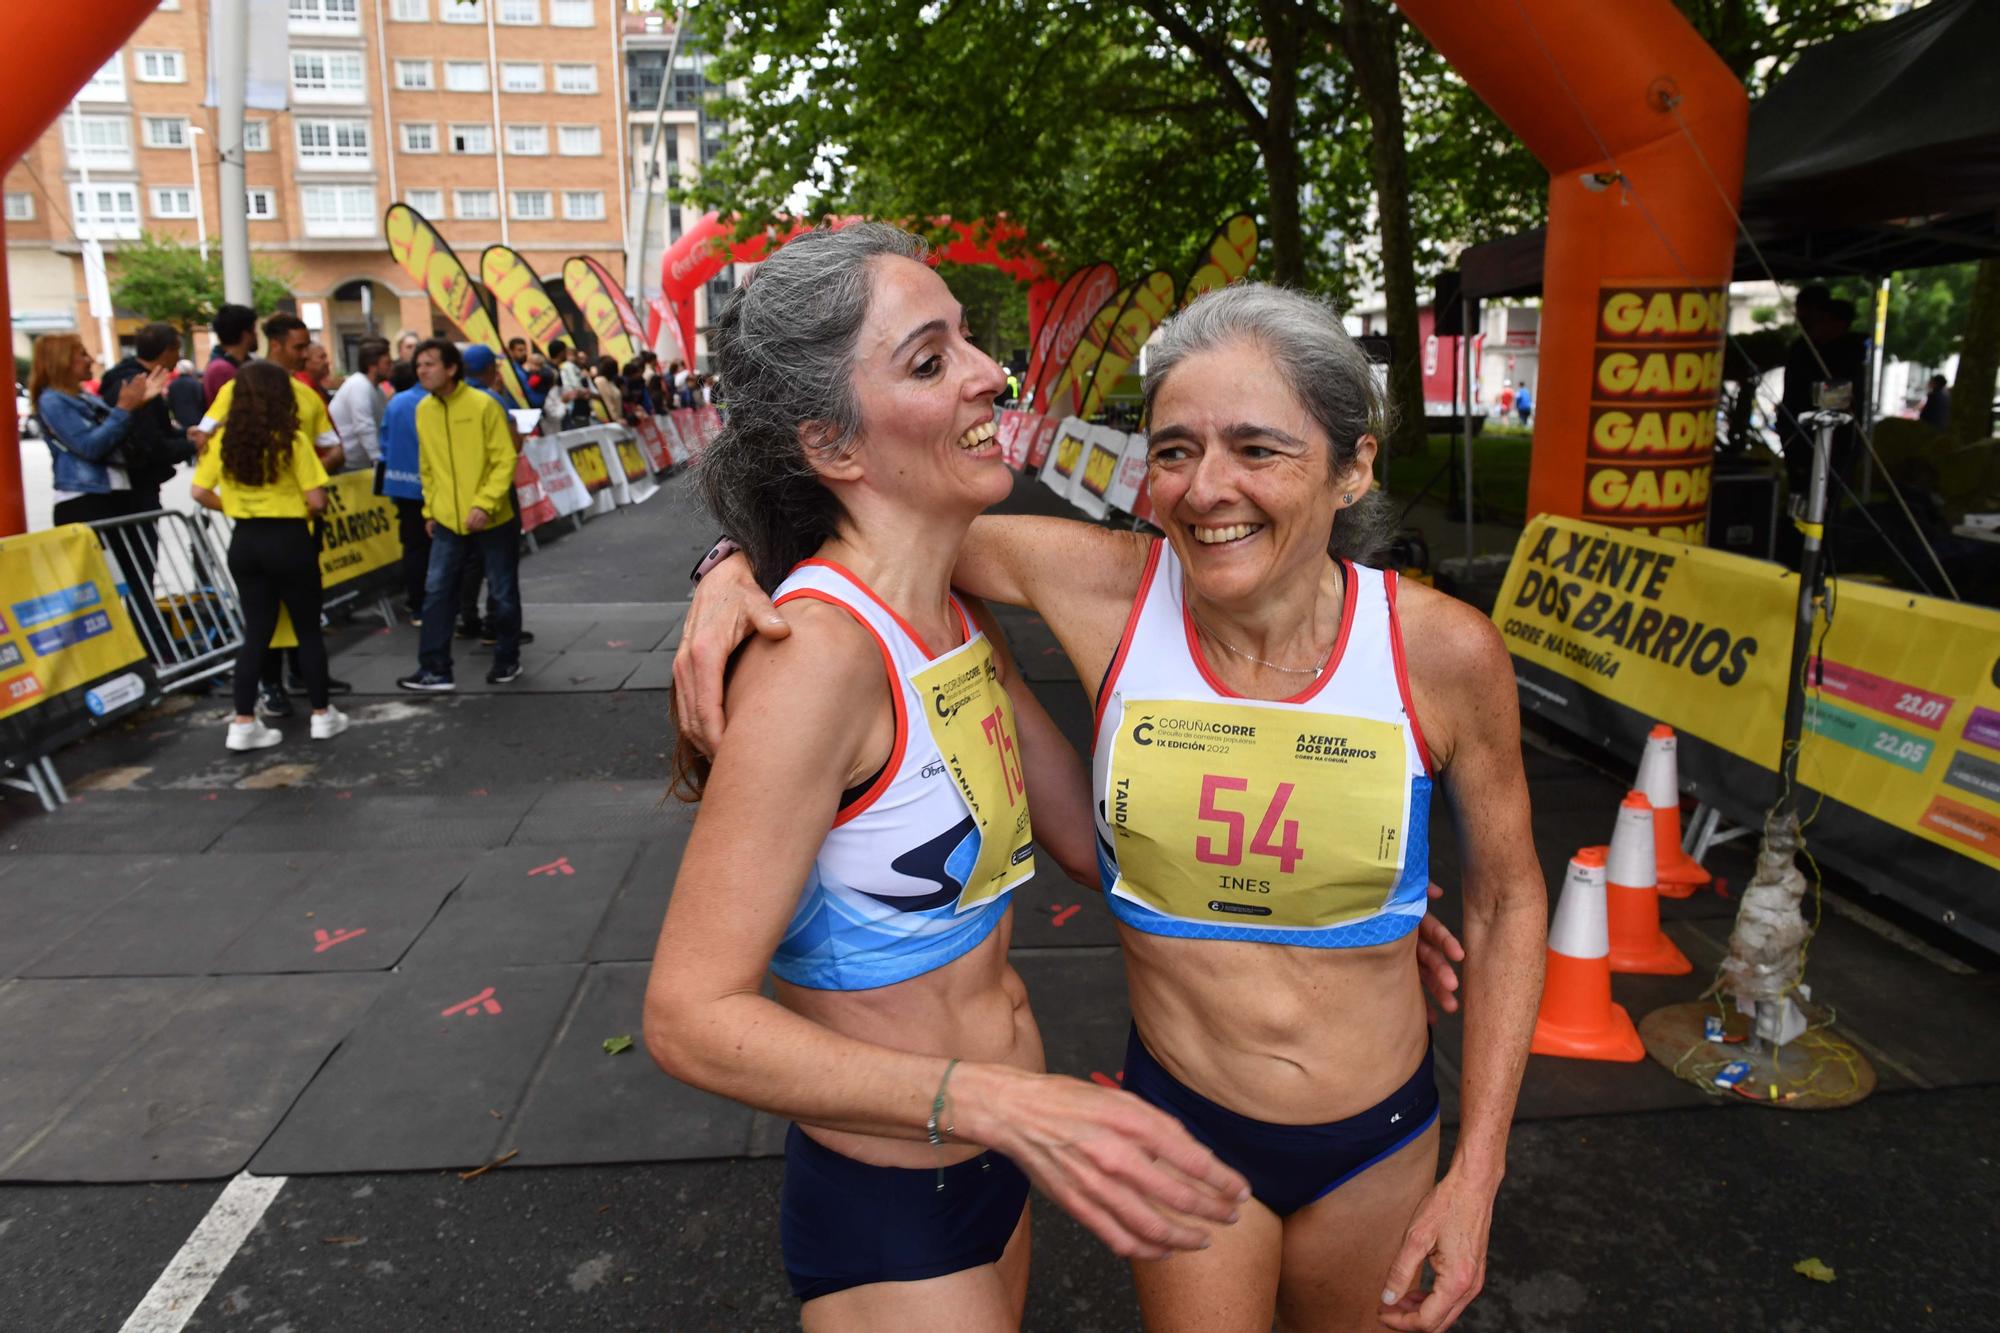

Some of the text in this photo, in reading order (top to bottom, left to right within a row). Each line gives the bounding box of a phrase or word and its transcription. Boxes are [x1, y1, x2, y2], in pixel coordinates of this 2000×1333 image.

[1528, 526, 1558, 566] A
[1551, 531, 1676, 600] XENTE
[1514, 569, 1758, 687] DOS BARRIOS
[1504, 618, 1621, 679] CORRE NA CORUÑA
[1893, 692, 1945, 720] 23.01
[1159, 717, 1256, 737] CORUÑACORRE
[1167, 740, 1206, 751] EDICIÓN
[1206, 744, 1230, 754] 2022
[1296, 743, 1377, 759] DOS BARRIOS
[1297, 734, 1348, 747] A XENTE
[1873, 731, 1927, 763] 22.05
[1324, 756, 1348, 764] CORUÑA
[950, 754, 980, 813] TANDA
[1195, 774, 1304, 874] 54
[1387, 828, 1396, 841] 54
[1218, 875, 1270, 894] INES
